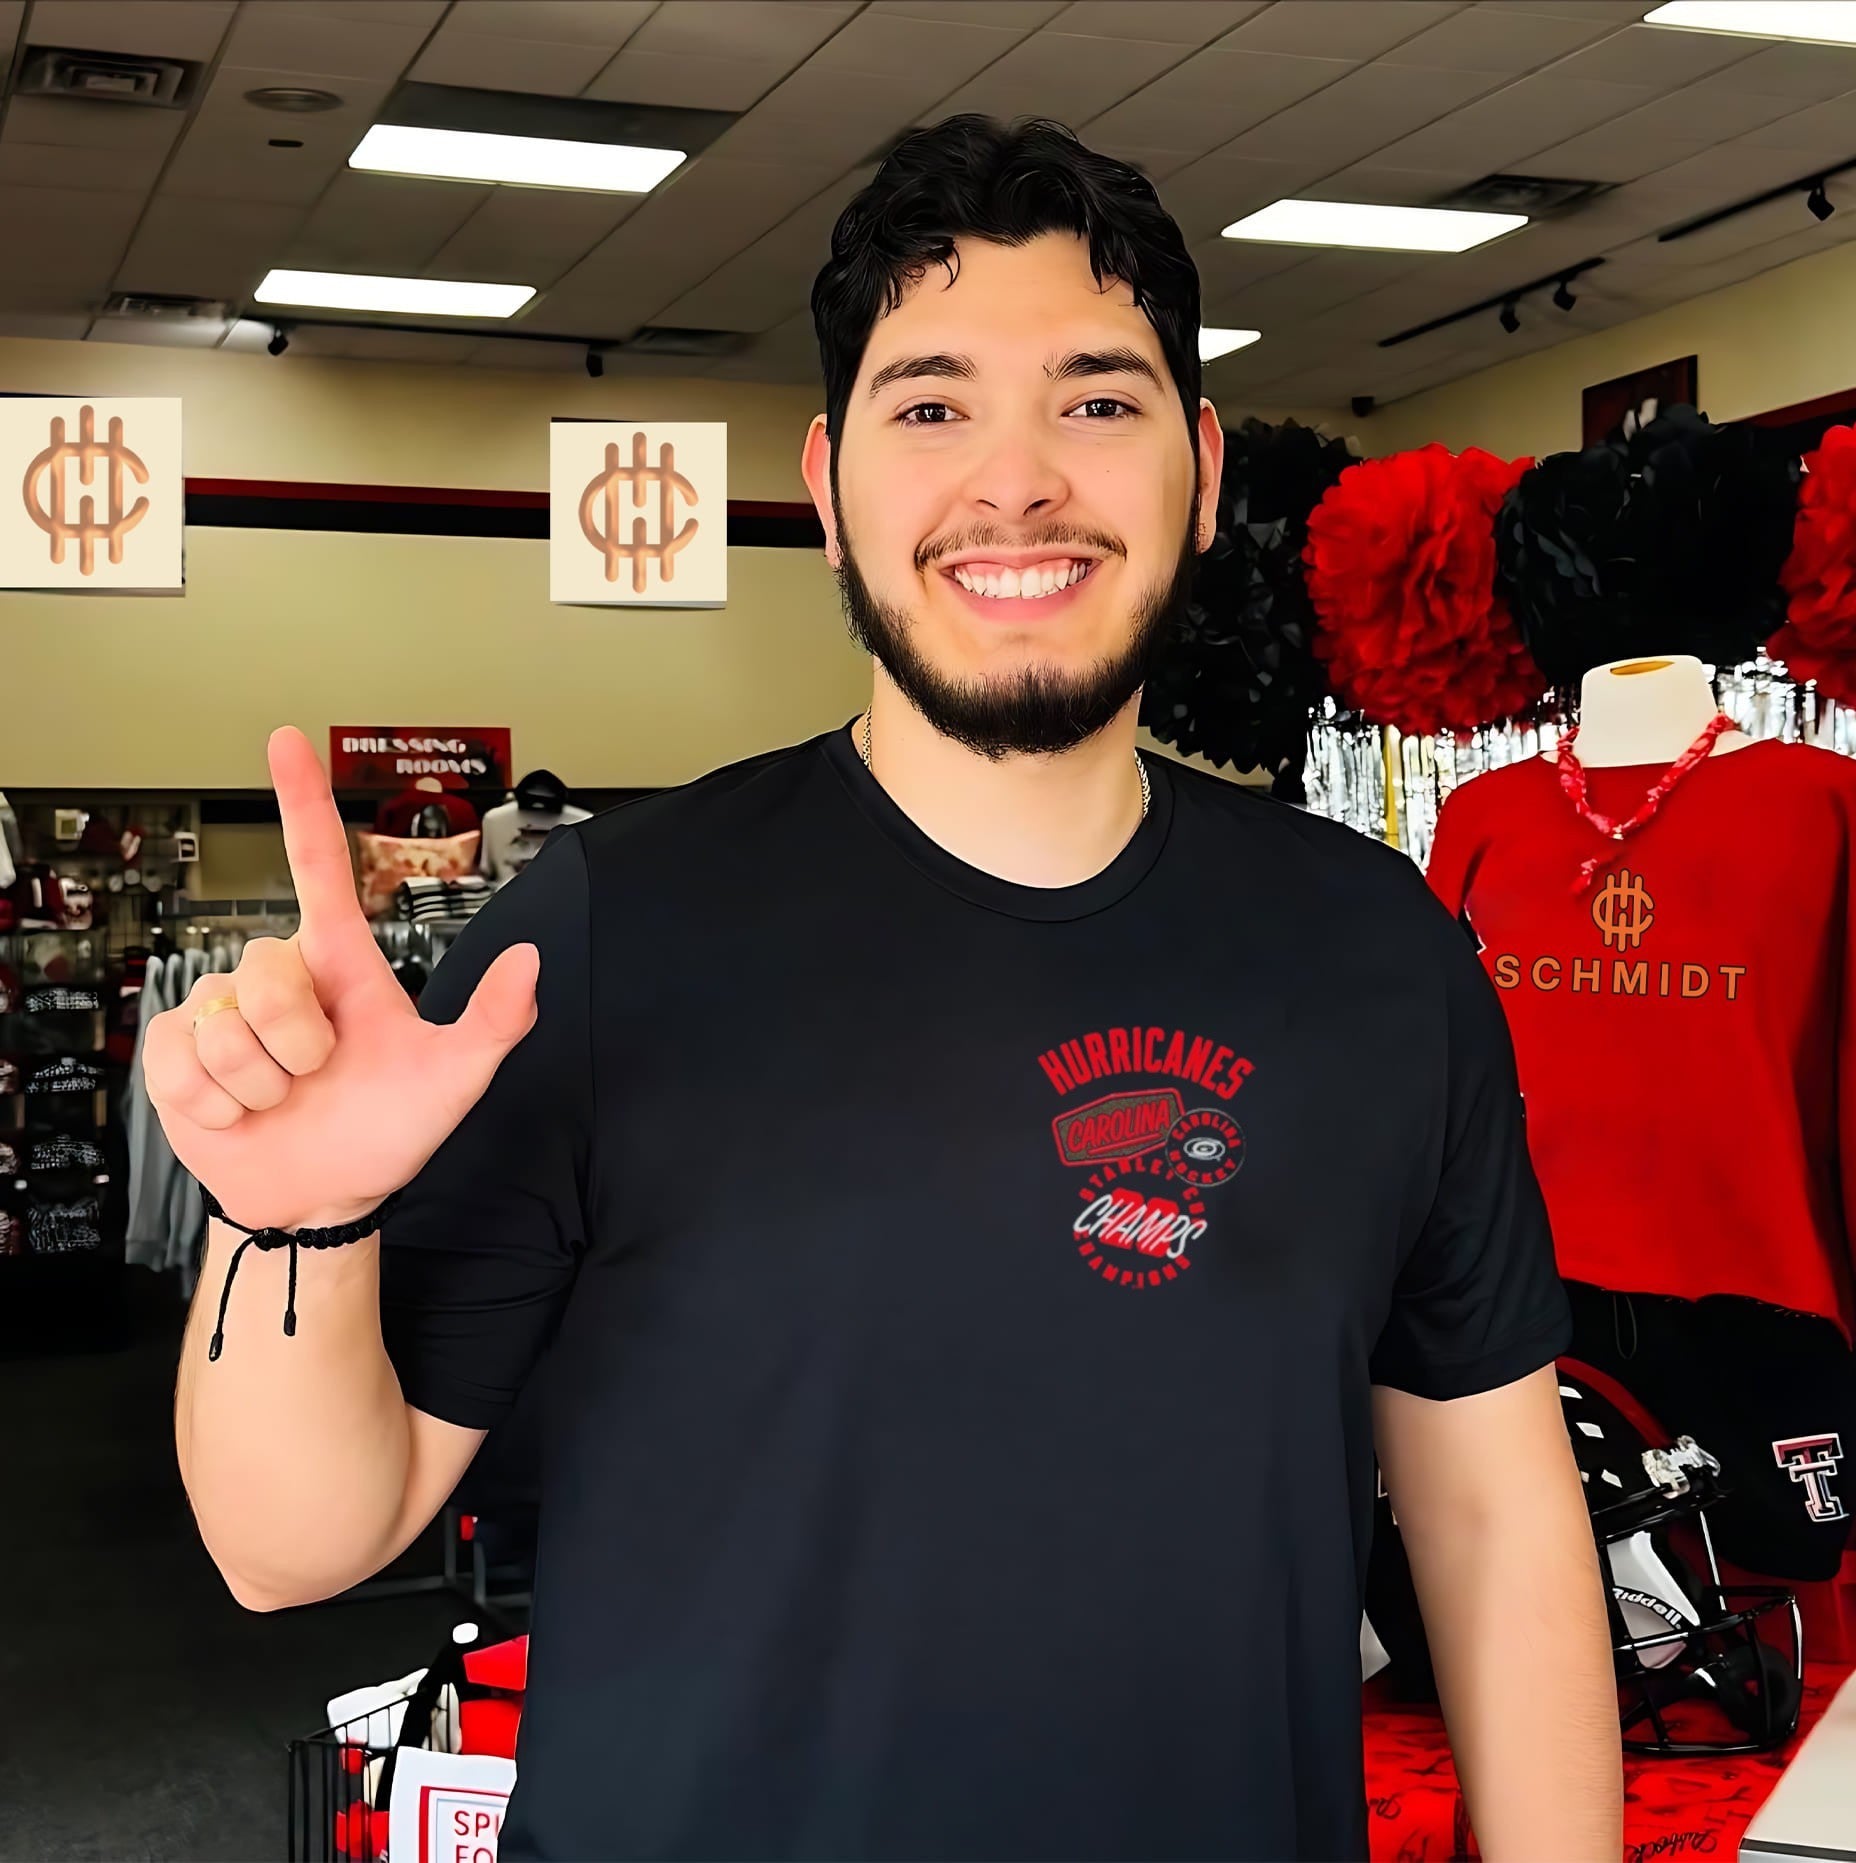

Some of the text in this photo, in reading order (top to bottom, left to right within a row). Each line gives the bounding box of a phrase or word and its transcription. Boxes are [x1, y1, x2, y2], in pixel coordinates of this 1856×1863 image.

[342, 737, 467, 754] DRESSING
[396, 758, 487, 775] ROOMS
[1494, 954, 1747, 1000] SCHMIDT
[1037, 1026, 1256, 1100] HURRICANES
[1066, 1099, 1171, 1153] CAROLINA
[1171, 1112, 1242, 1149] CAROLINA
[1169, 1150, 1236, 1184] HOCKEY
[1073, 1194, 1208, 1259] CHAMPS
